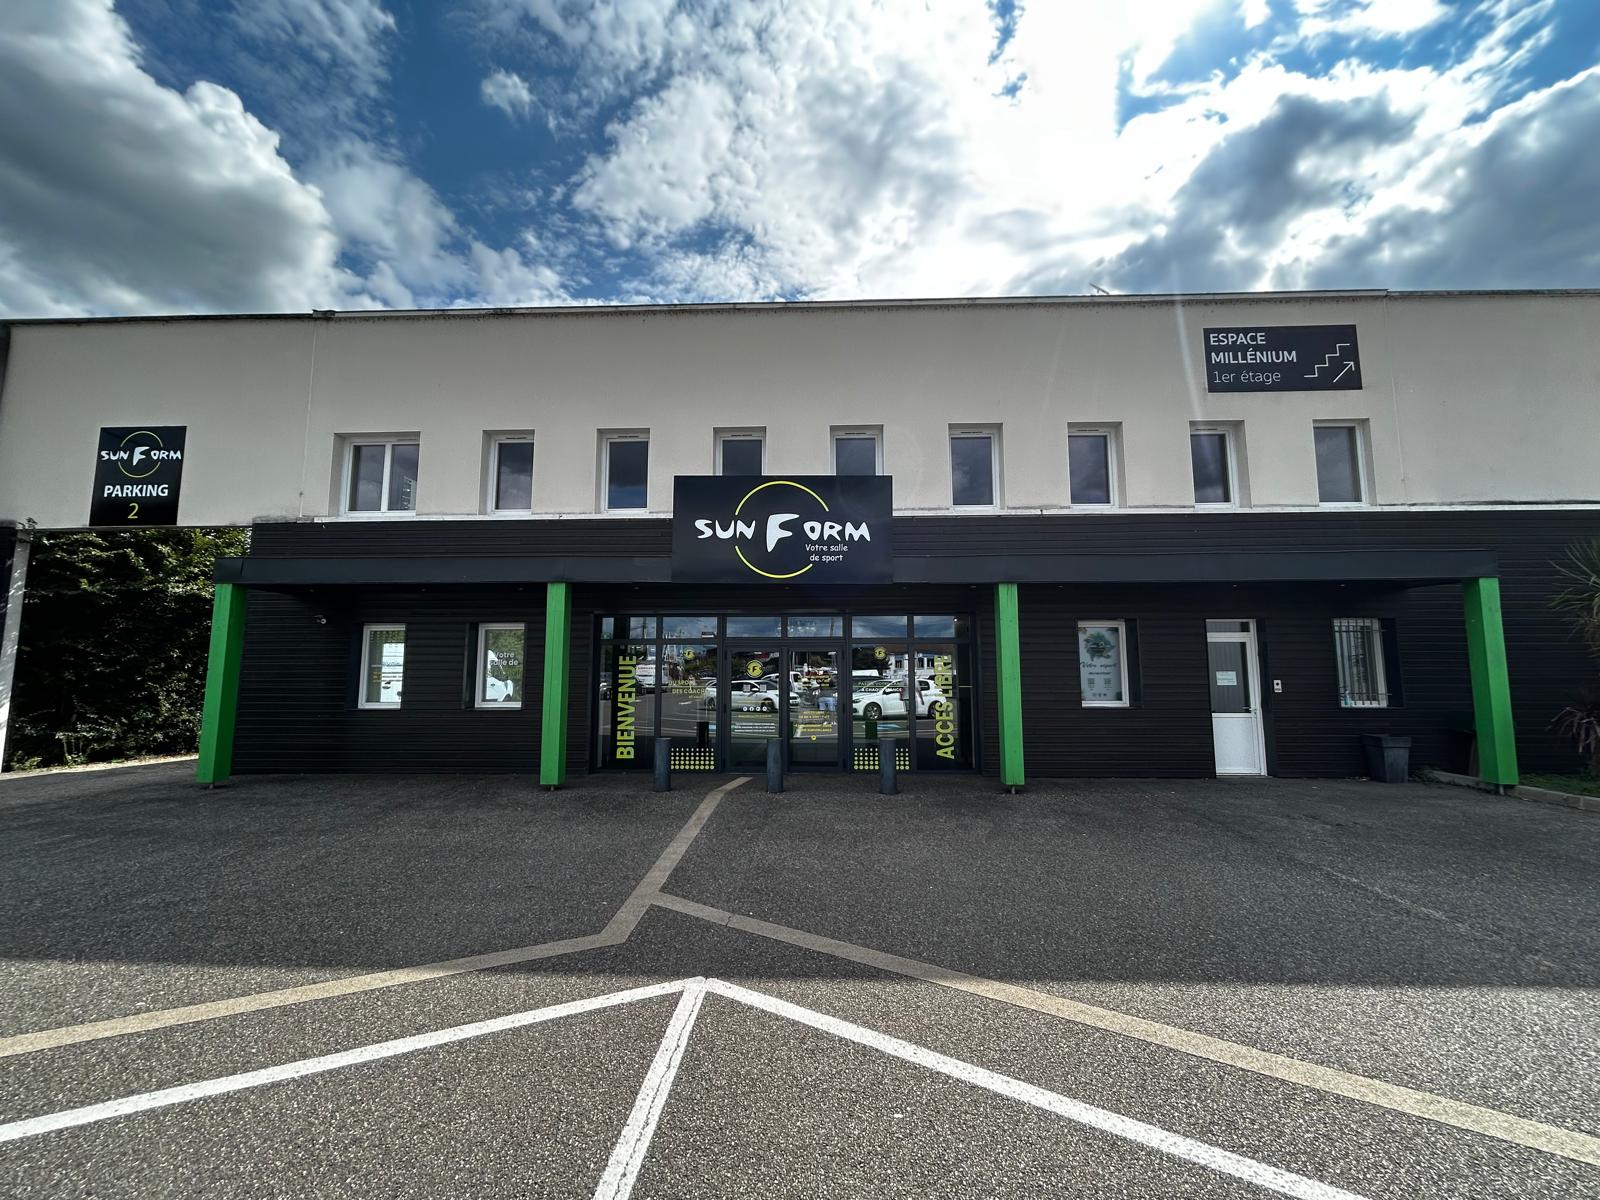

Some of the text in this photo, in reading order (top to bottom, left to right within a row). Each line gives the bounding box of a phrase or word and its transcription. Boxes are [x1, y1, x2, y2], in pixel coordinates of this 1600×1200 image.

[1210, 332, 1266, 345] ESPACE
[1211, 348, 1296, 364] MILLÉNIUM
[1214, 370, 1280, 384] 1er étage
[100, 450, 130, 460] SUN
[104, 484, 168, 497] PARKING
[128, 502, 139, 518] 2
[694, 519, 756, 539] SUN
[805, 543, 848, 552] Votre salle
[810, 553, 844, 562] de sport
[616, 655, 637, 760] BIENVENUE
[935, 701, 954, 760] ACCES
